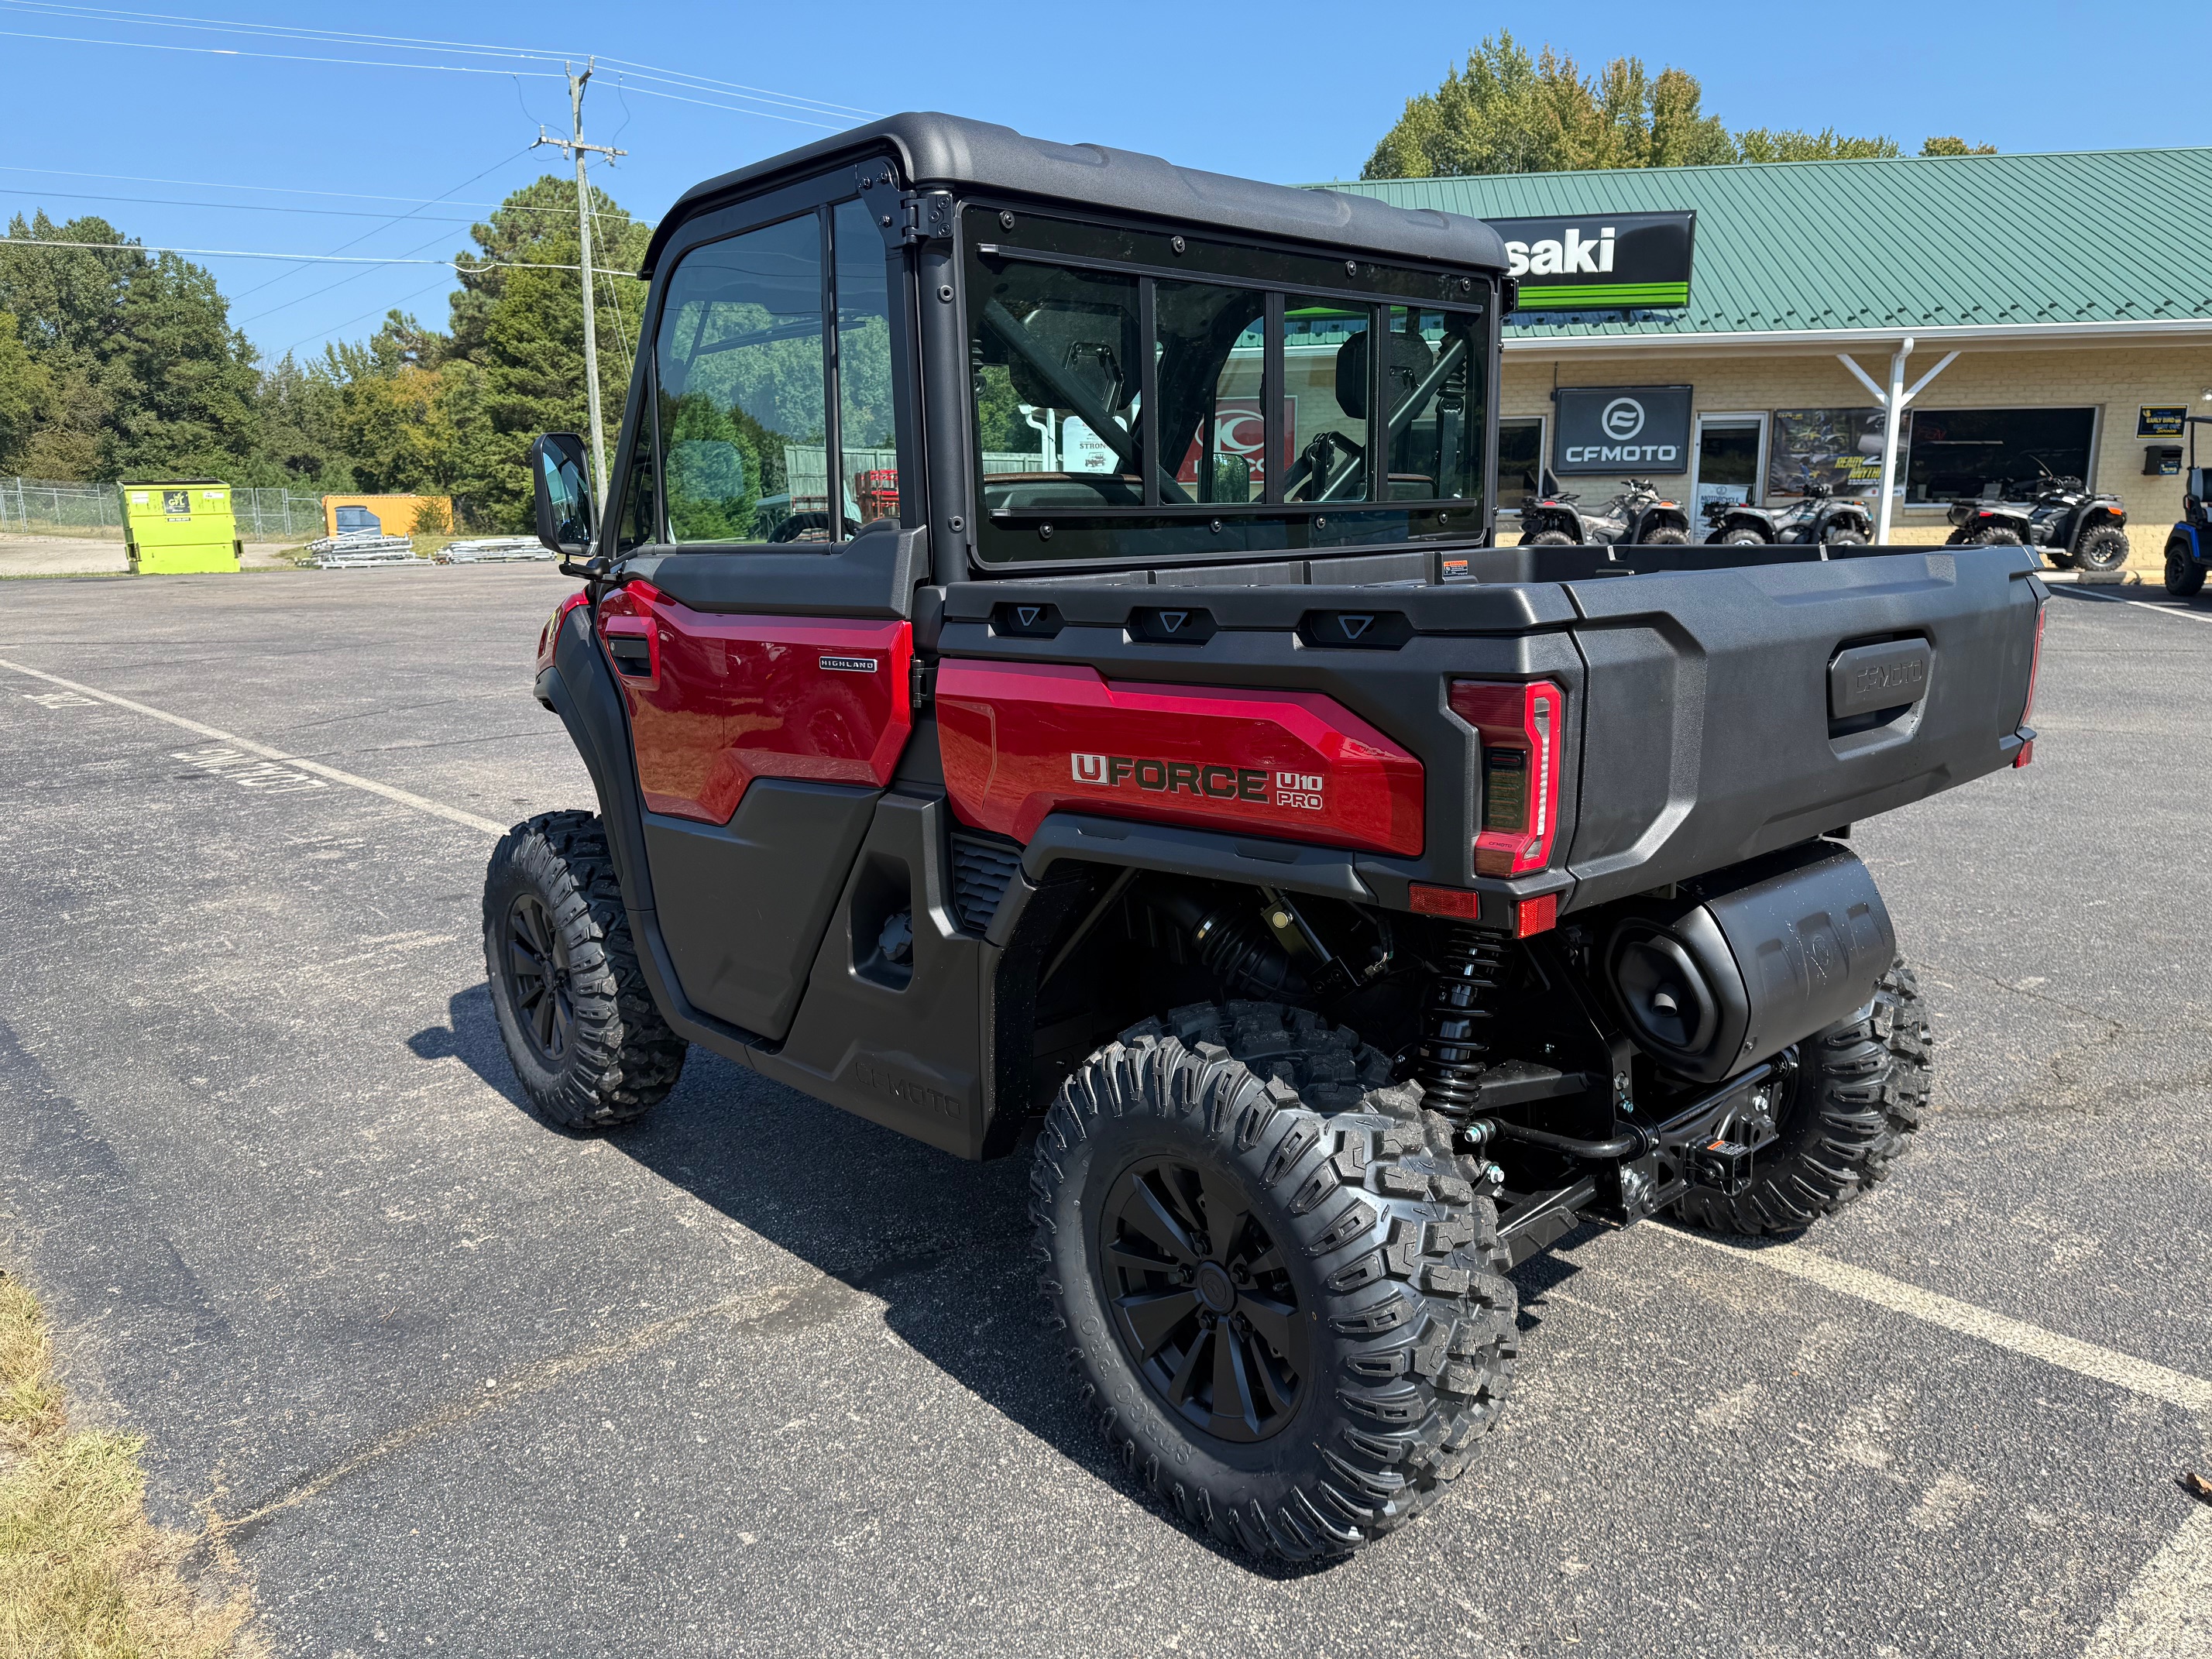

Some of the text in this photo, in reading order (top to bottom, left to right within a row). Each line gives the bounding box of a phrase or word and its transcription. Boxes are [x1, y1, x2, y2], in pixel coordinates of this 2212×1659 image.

[1566, 445, 1677, 462] CFMOTO
[1835, 456, 1865, 469] READY
[168, 495, 185, 506] GFL
[821, 660, 874, 668] HIGHLAND
[1856, 658, 1922, 693] CFMOTO
[1276, 771, 1323, 791] U10
[1277, 791, 1323, 810] PRO
[1080, 1316, 1121, 1378] PRO
